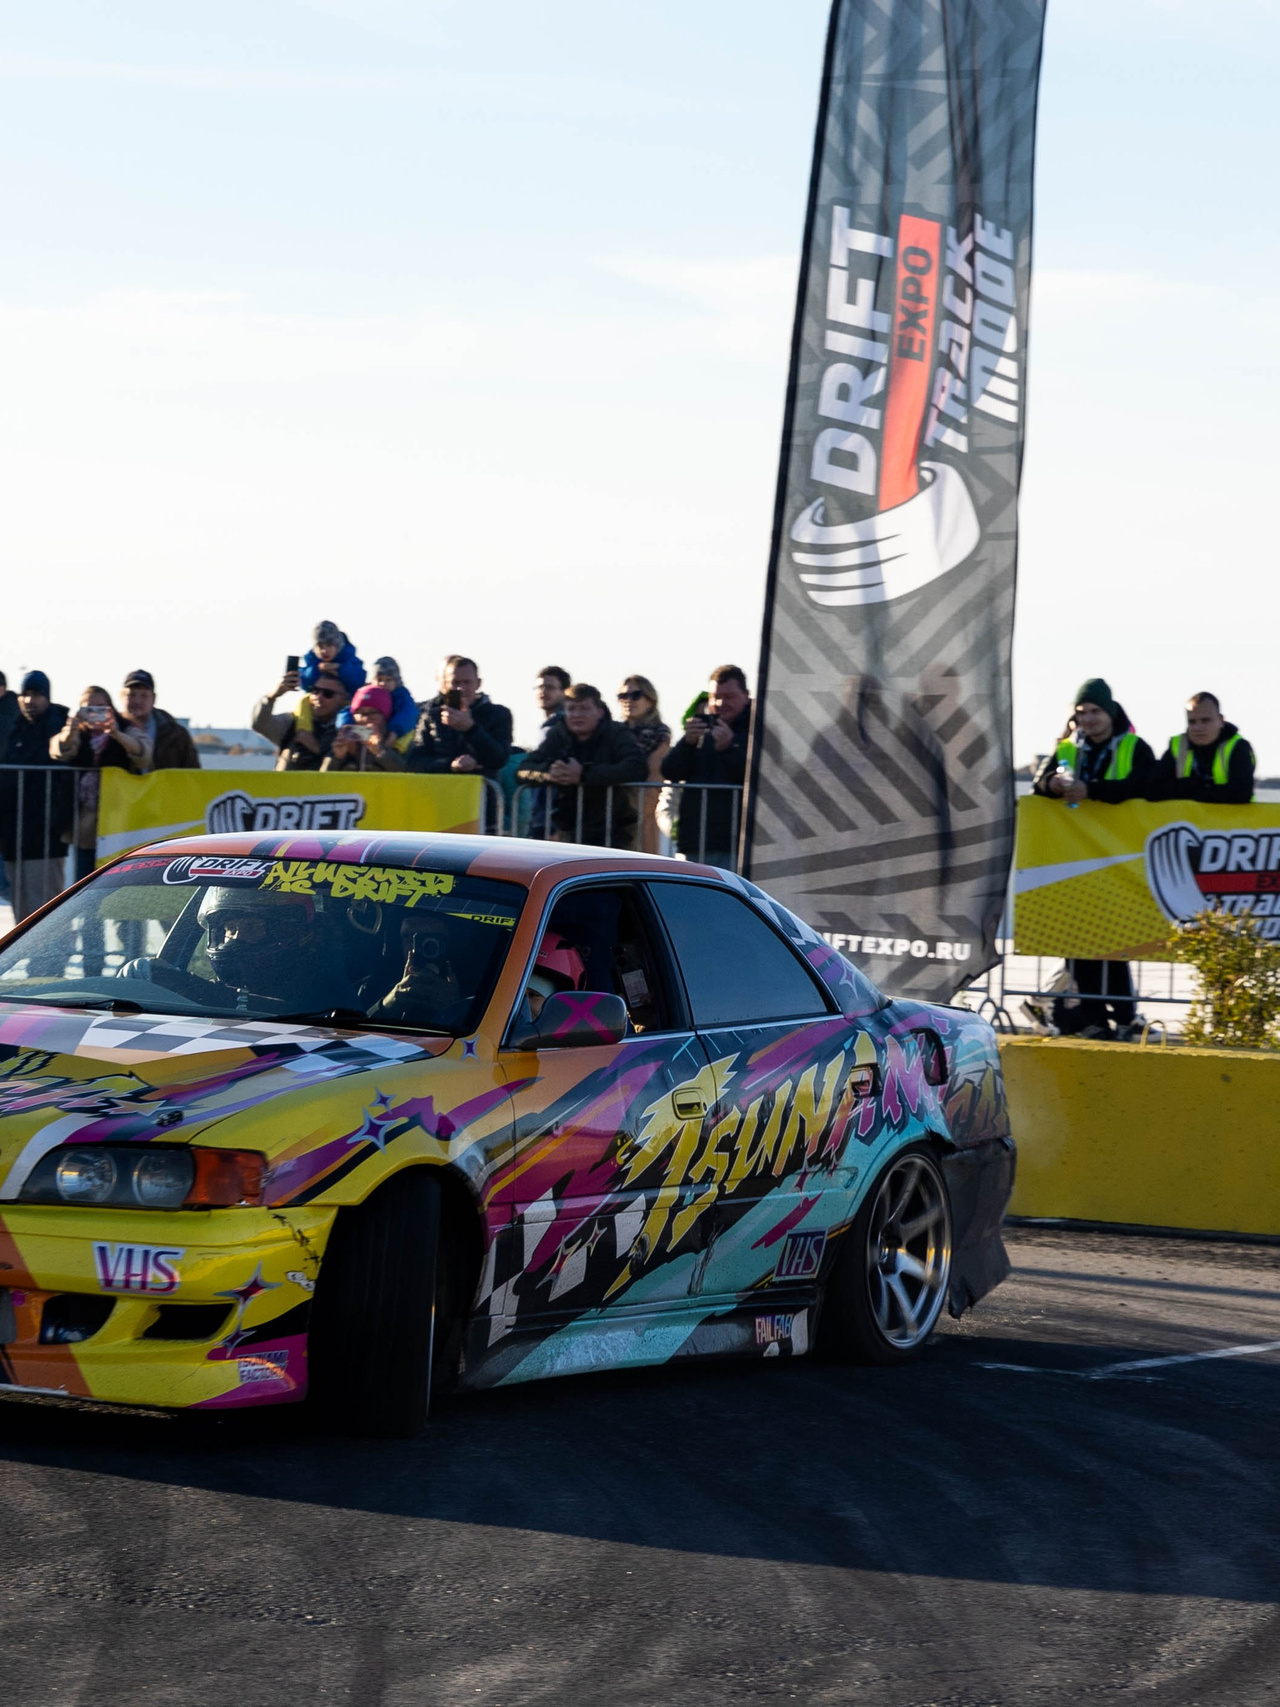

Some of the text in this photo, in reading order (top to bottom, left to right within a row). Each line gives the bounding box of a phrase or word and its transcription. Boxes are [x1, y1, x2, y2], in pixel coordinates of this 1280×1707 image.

[897, 246, 933, 363] EXPO
[811, 205, 893, 496] DRIFT
[253, 802, 357, 831] DRIFT
[196, 857, 271, 870] DRIFT
[221, 868, 255, 877] EXPO
[1199, 836, 1280, 872] DRIF
[96, 1244, 181, 1292] VHS
[781, 1235, 824, 1275] VHS
